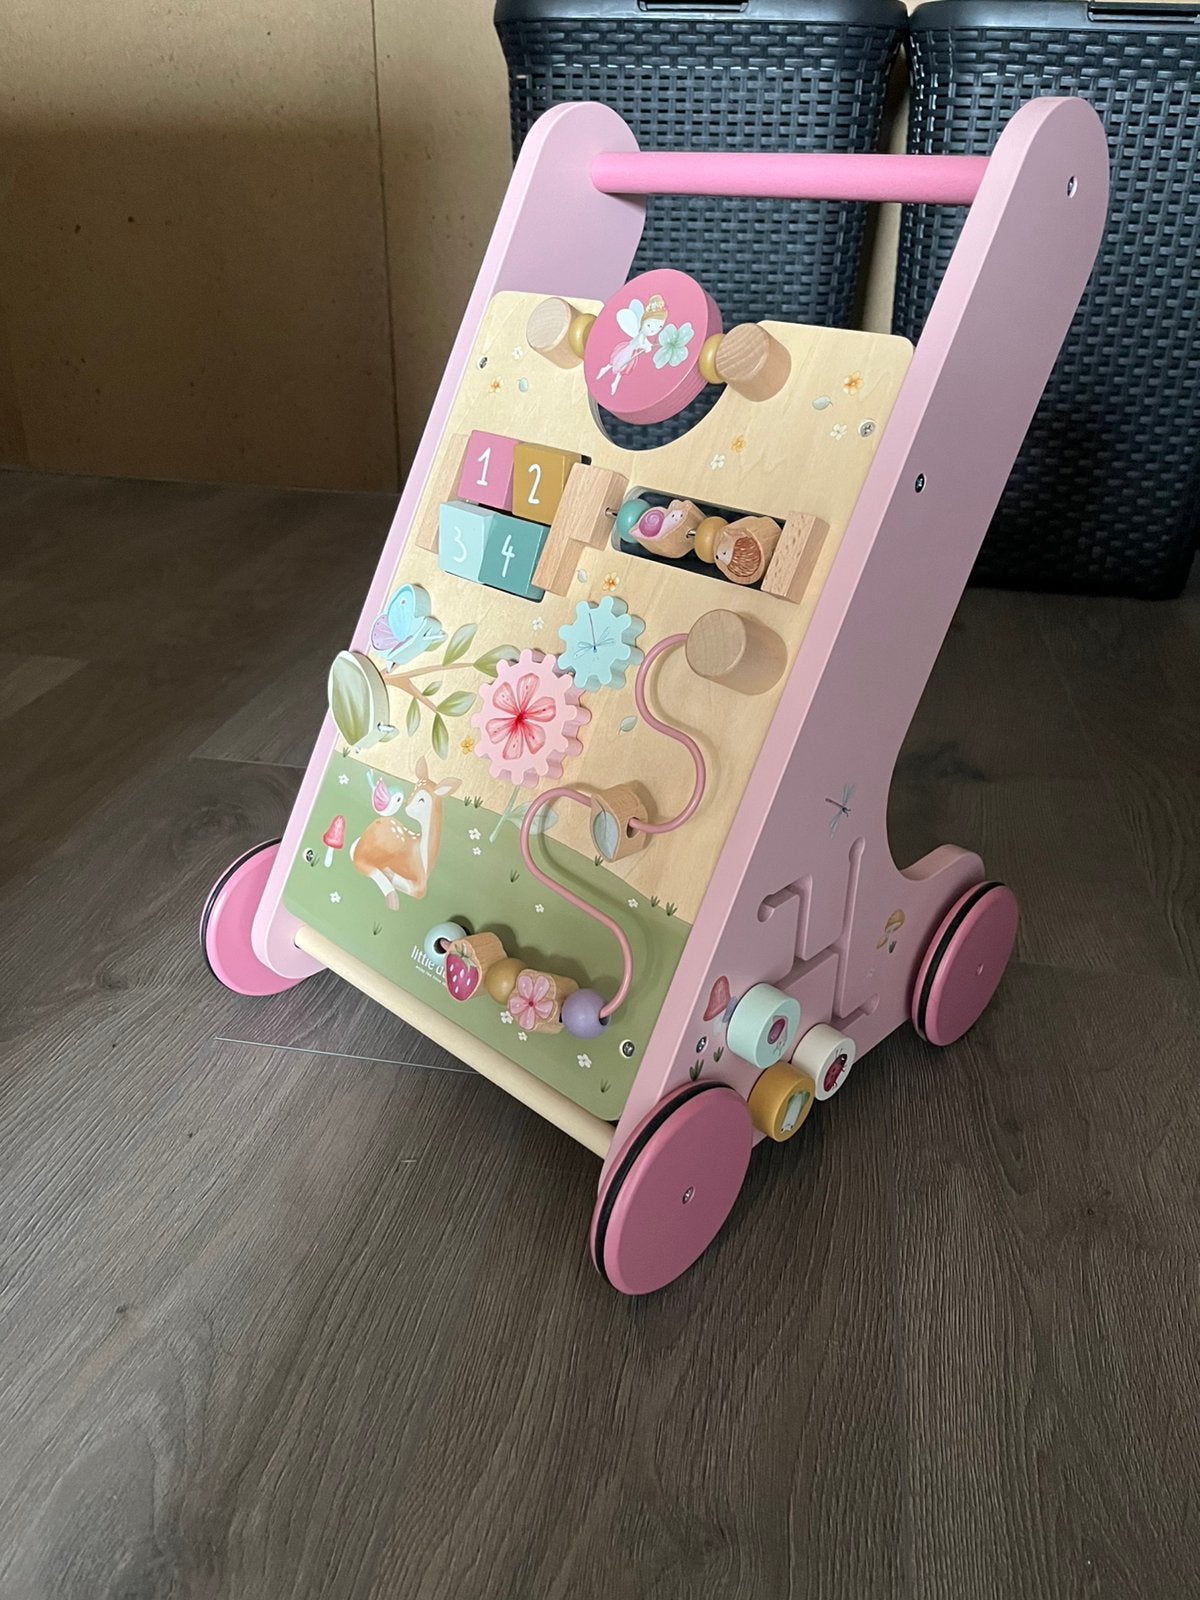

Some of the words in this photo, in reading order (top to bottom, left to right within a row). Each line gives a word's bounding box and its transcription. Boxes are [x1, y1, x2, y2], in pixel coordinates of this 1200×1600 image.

[476, 447, 492, 486] 1
[528, 463, 542, 505] 2
[453, 526, 467, 563] 3
[501, 534, 516, 578] 4
